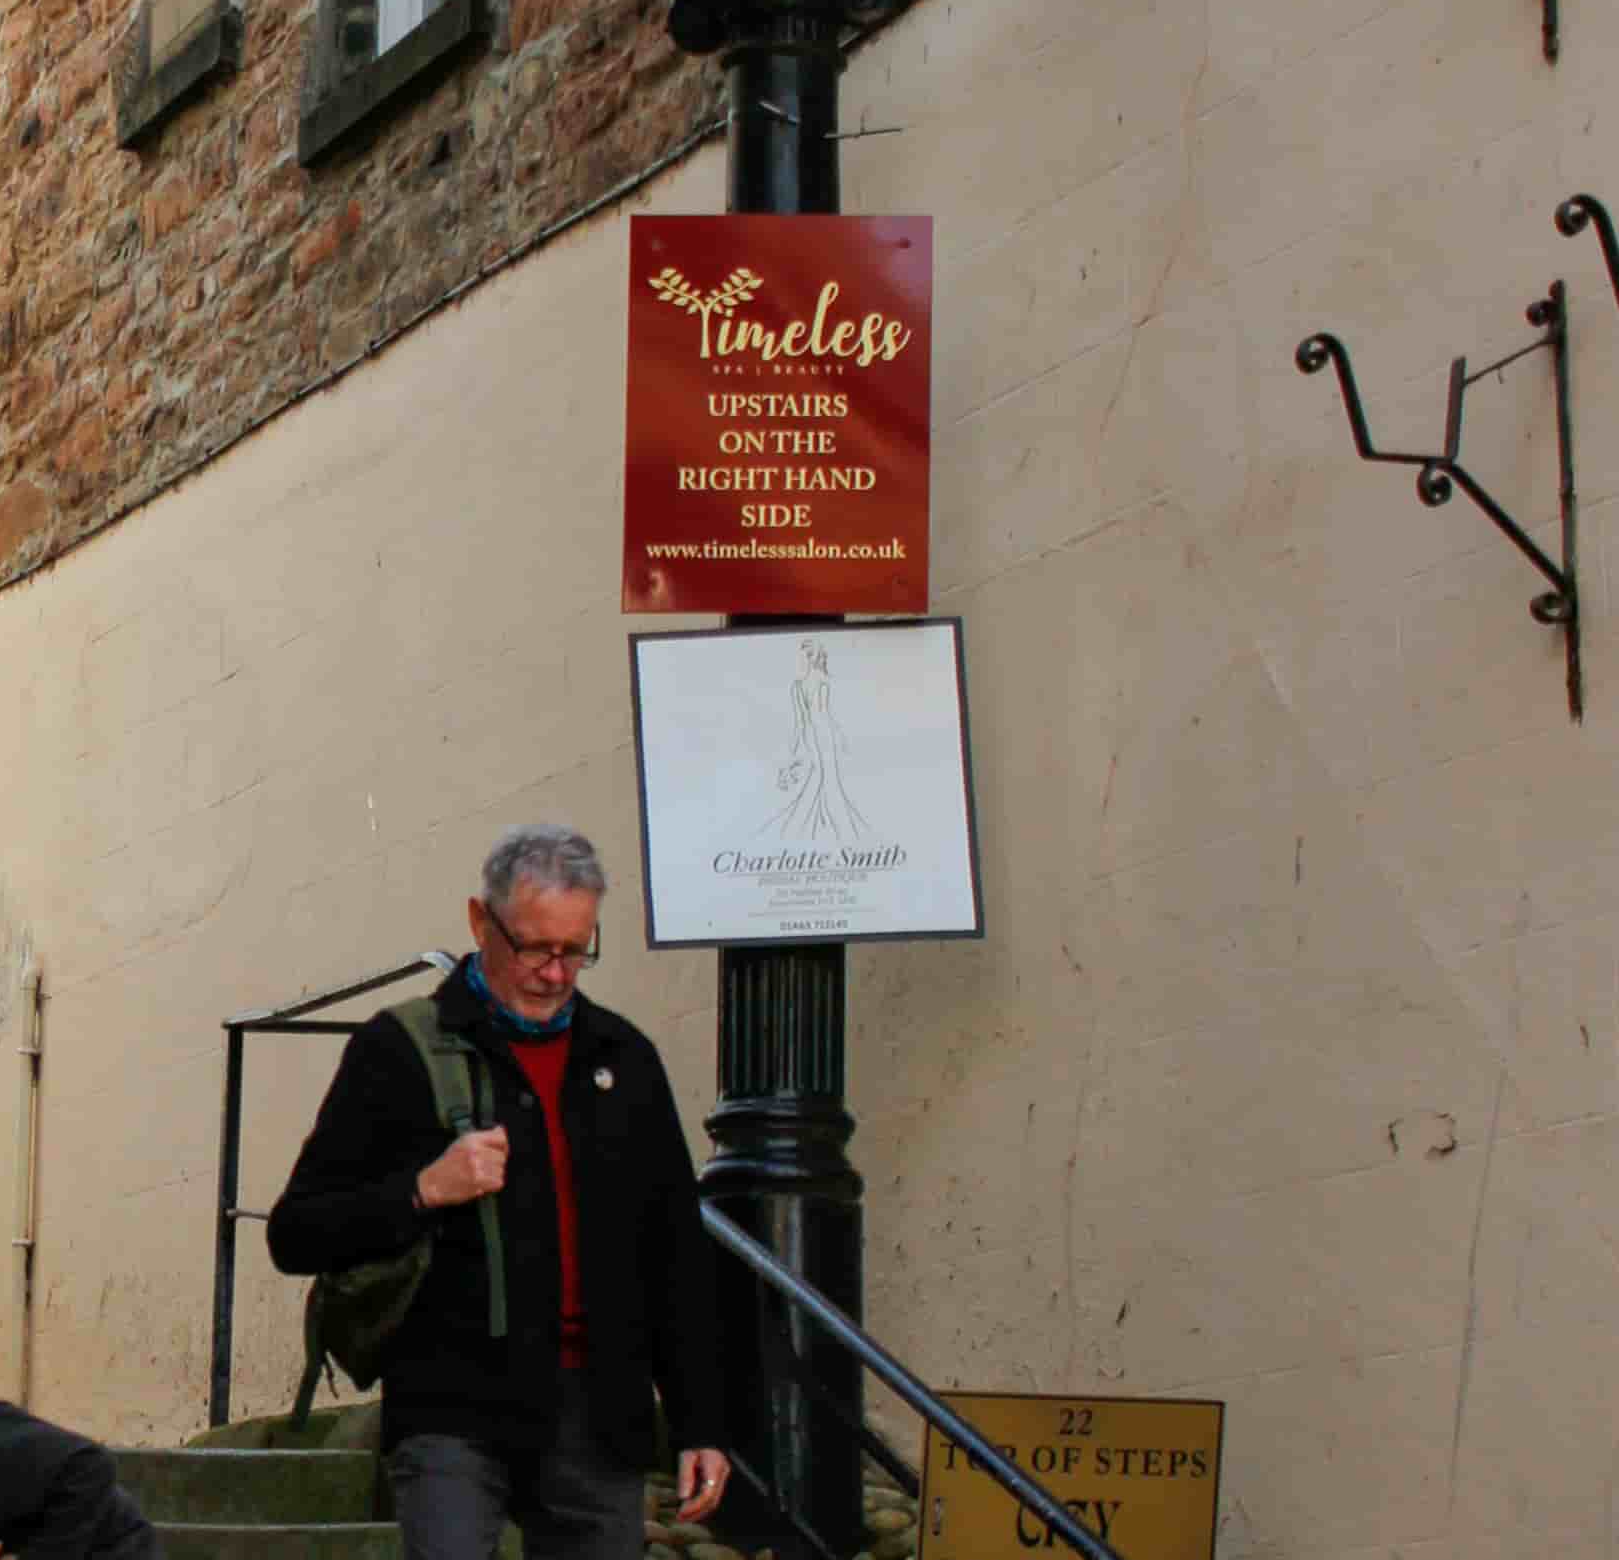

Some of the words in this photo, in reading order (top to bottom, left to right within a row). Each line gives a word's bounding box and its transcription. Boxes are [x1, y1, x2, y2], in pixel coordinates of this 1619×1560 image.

[647, 266, 911, 368] Timeless
[708, 393, 848, 418] UPSTAIRS
[719, 430, 764, 455] ON
[769, 430, 836, 455] THE
[678, 467, 779, 492] RIGHT
[784, 467, 877, 492] HAND
[740, 503, 813, 529] SIDE
[646, 537, 907, 561] www.timelesssalon.co.uk
[835, 843, 908, 870] Smith
[1059, 1408, 1094, 1437] 22
[939, 1442, 1018, 1471] TP
[1031, 1445, 1081, 1474] OF
[1094, 1447, 1208, 1479] STEPS
